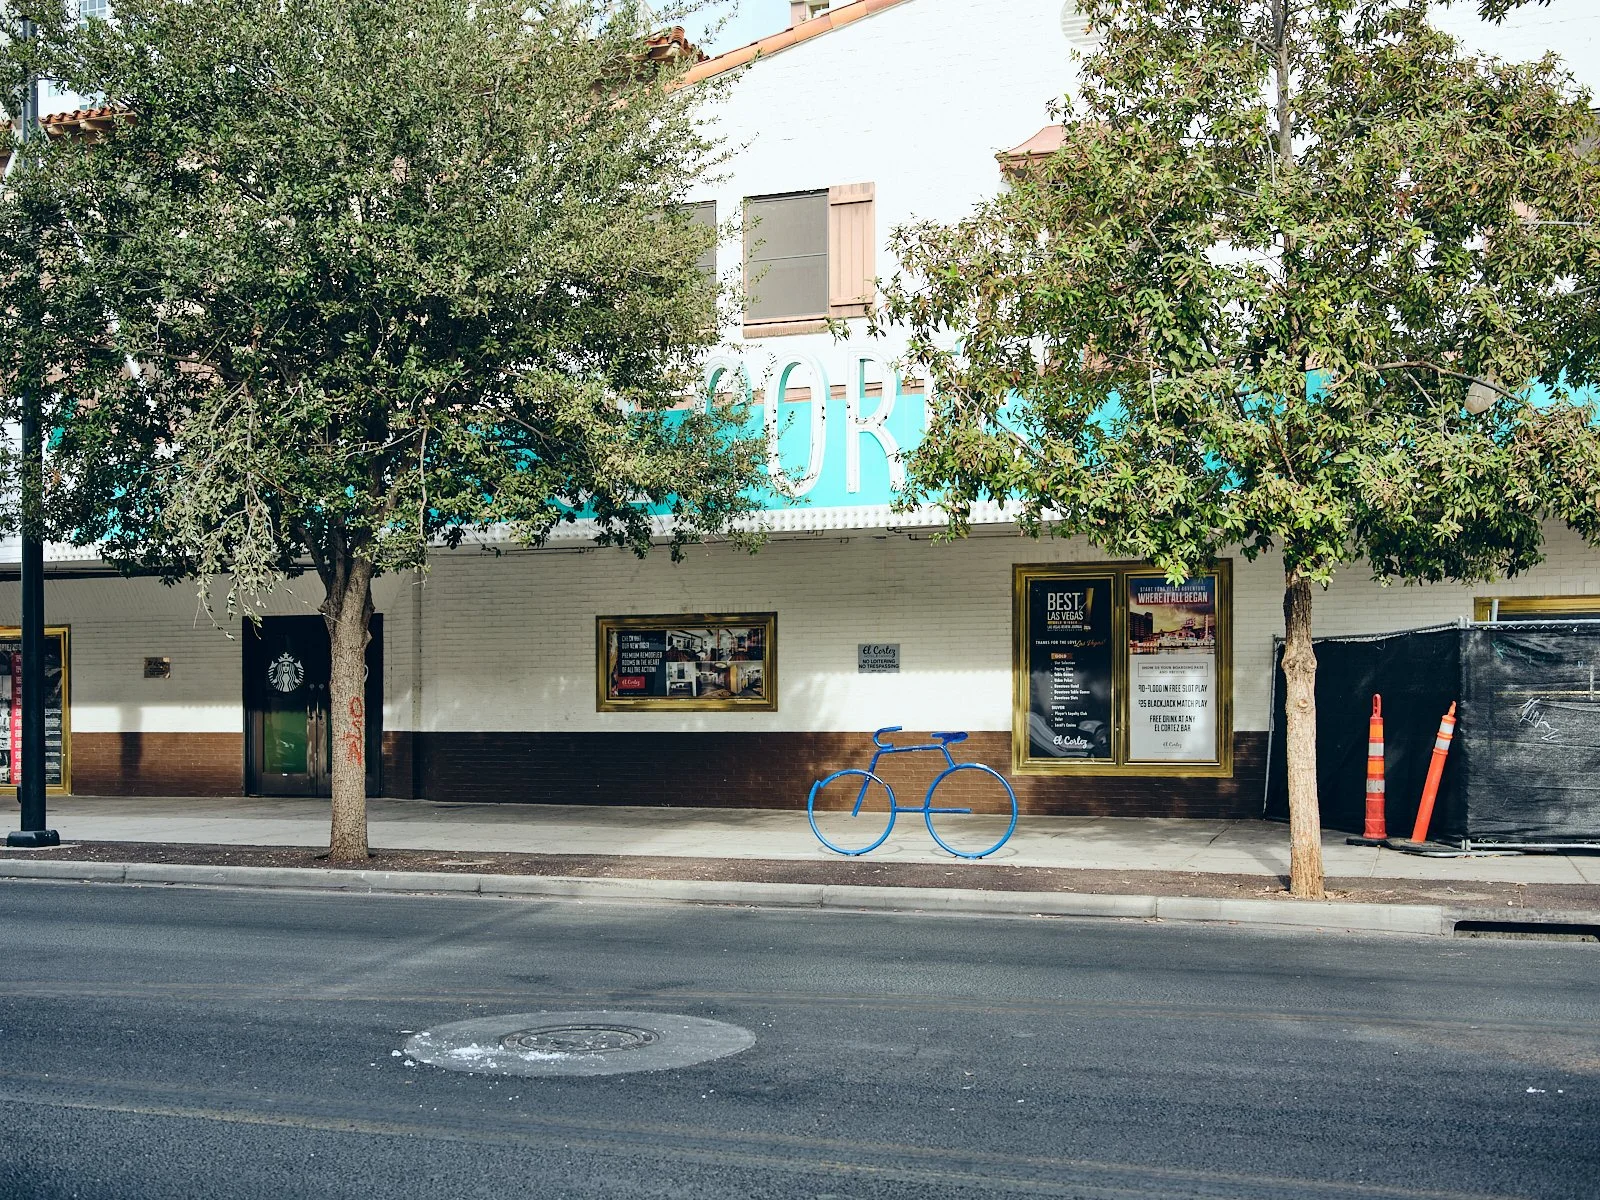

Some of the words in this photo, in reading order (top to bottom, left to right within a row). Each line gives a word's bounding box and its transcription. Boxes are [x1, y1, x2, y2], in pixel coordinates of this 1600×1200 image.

[1047, 592, 1081, 611] BEST
[1138, 592, 1163, 604] WHERE
[1163, 592, 1171, 603] IT
[1171, 591, 1183, 603] ALL
[1184, 591, 1208, 603] BEGAN
[1047, 611, 1060, 621] LAS
[1061, 611, 1084, 621] VEGAS
[863, 645, 872, 655] El
[873, 645, 896, 658] Cortez
[1163, 684, 1169, 692] IN
[1169, 684, 1181, 692] FREE
[1182, 684, 1194, 692] SLOT
[1195, 684, 1208, 692] PLAY
[1147, 699, 1176, 707] BLACKJACK
[1176, 699, 1194, 707] MATCH
[1195, 699, 1208, 707] PLAY
[1149, 715, 1162, 723] FREE
[1162, 715, 1178, 723] DRINK
[1178, 715, 1185, 723] AT
[1185, 715, 1195, 723] ANY
[1053, 735, 1063, 745] El
[1064, 735, 1088, 749] Cortez
